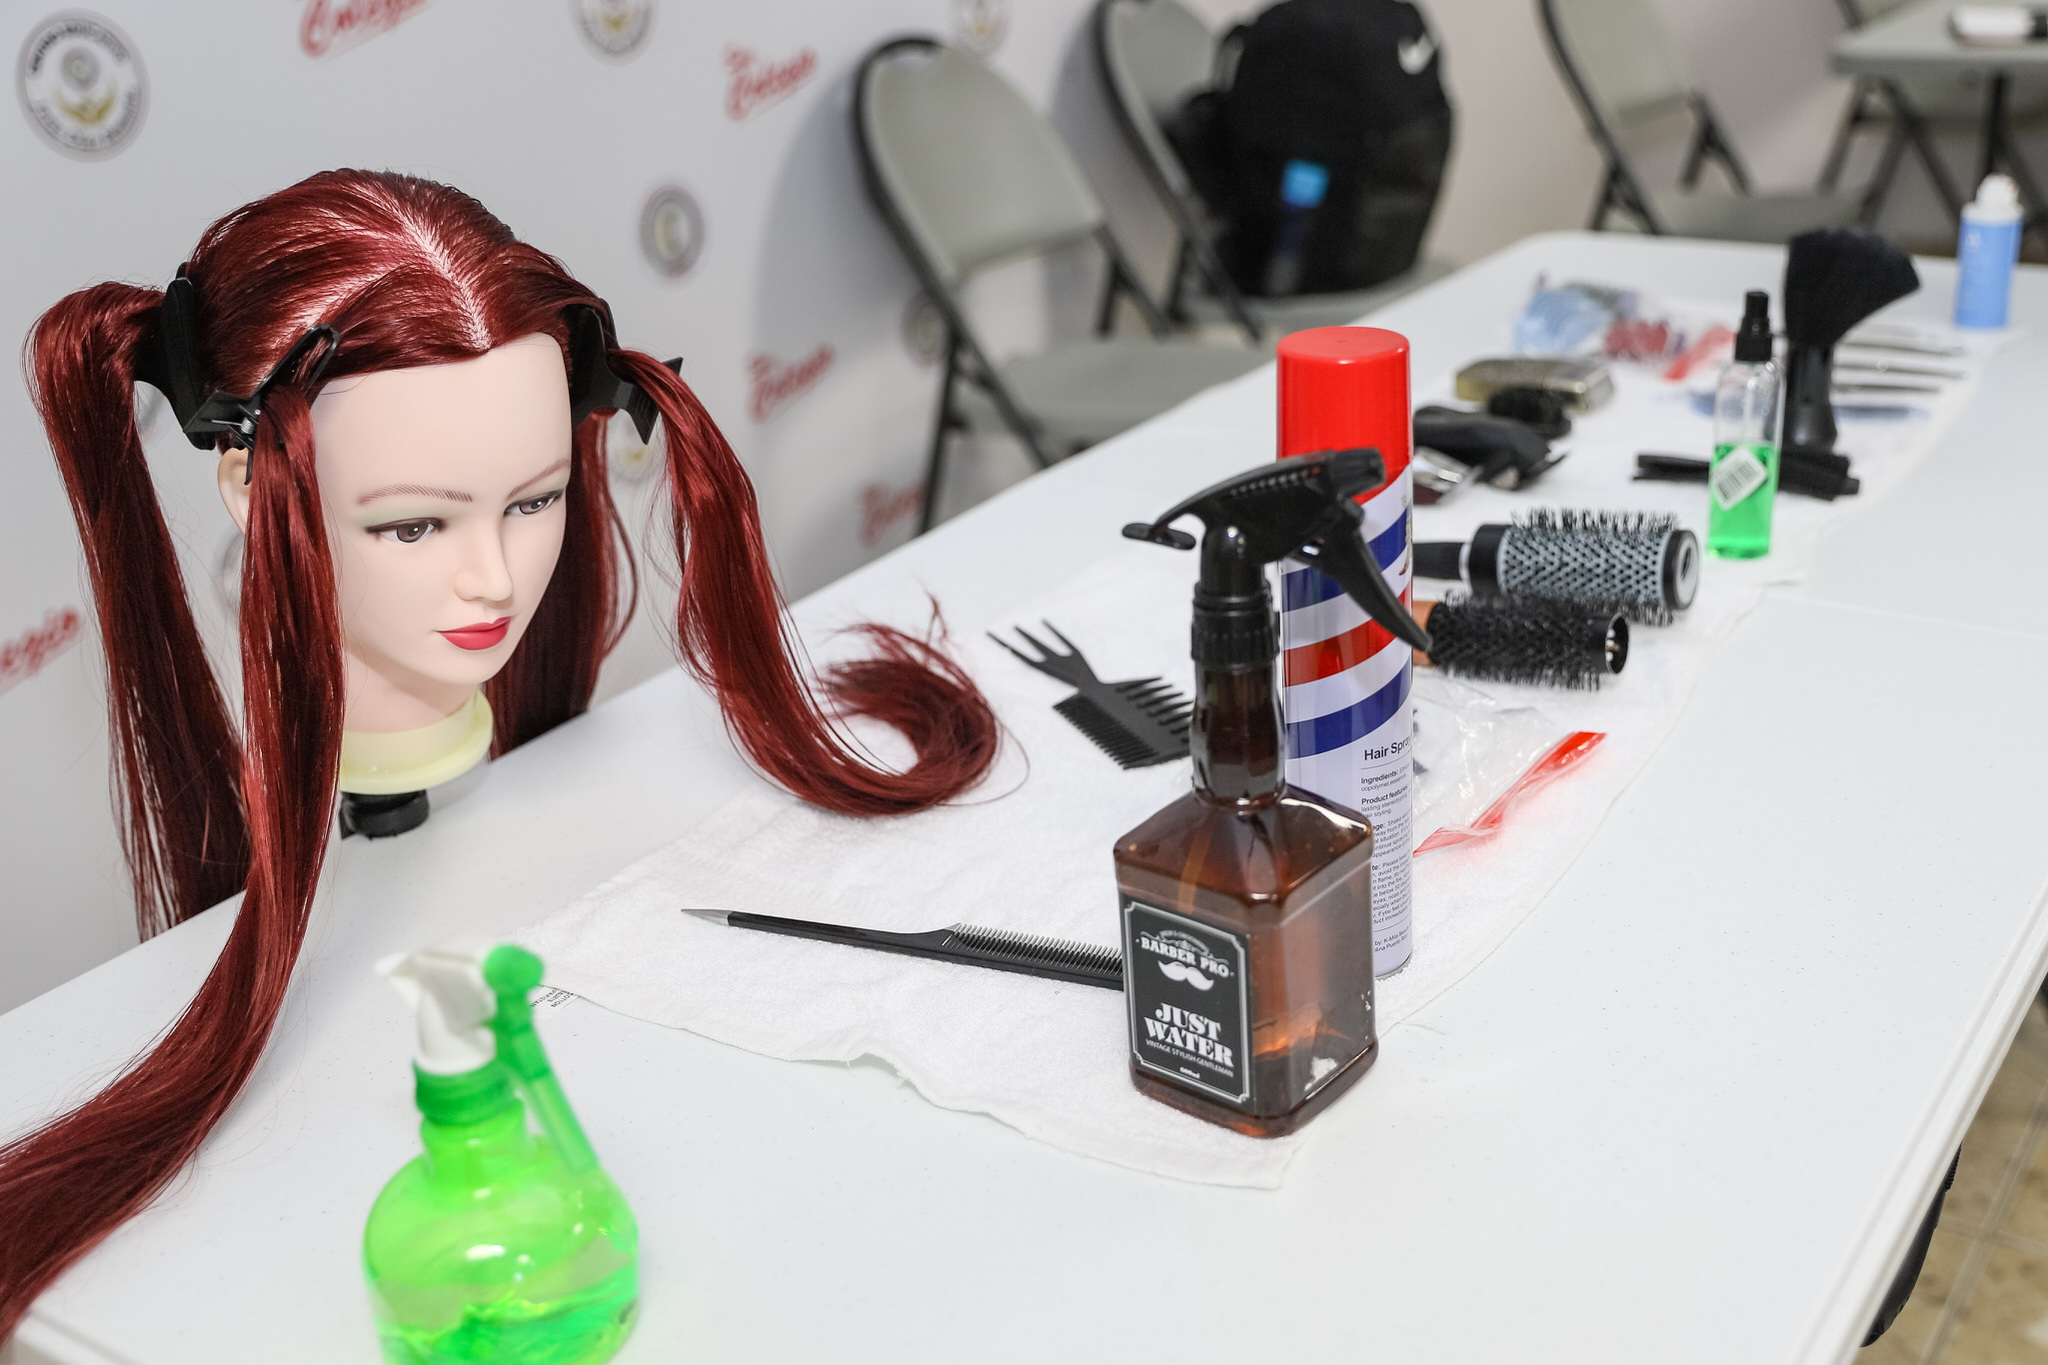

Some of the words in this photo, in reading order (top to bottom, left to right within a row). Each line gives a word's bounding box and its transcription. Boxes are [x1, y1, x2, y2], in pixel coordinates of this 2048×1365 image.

[1364, 746, 1389, 761] Hair
[1390, 736, 1410, 754] Spra
[1361, 794, 1388, 805] Product
[1140, 936, 1197, 966] BARBER
[1200, 956, 1230, 978] PRO
[1155, 1002, 1222, 1041] JUST
[1144, 1016, 1235, 1068] WATER
